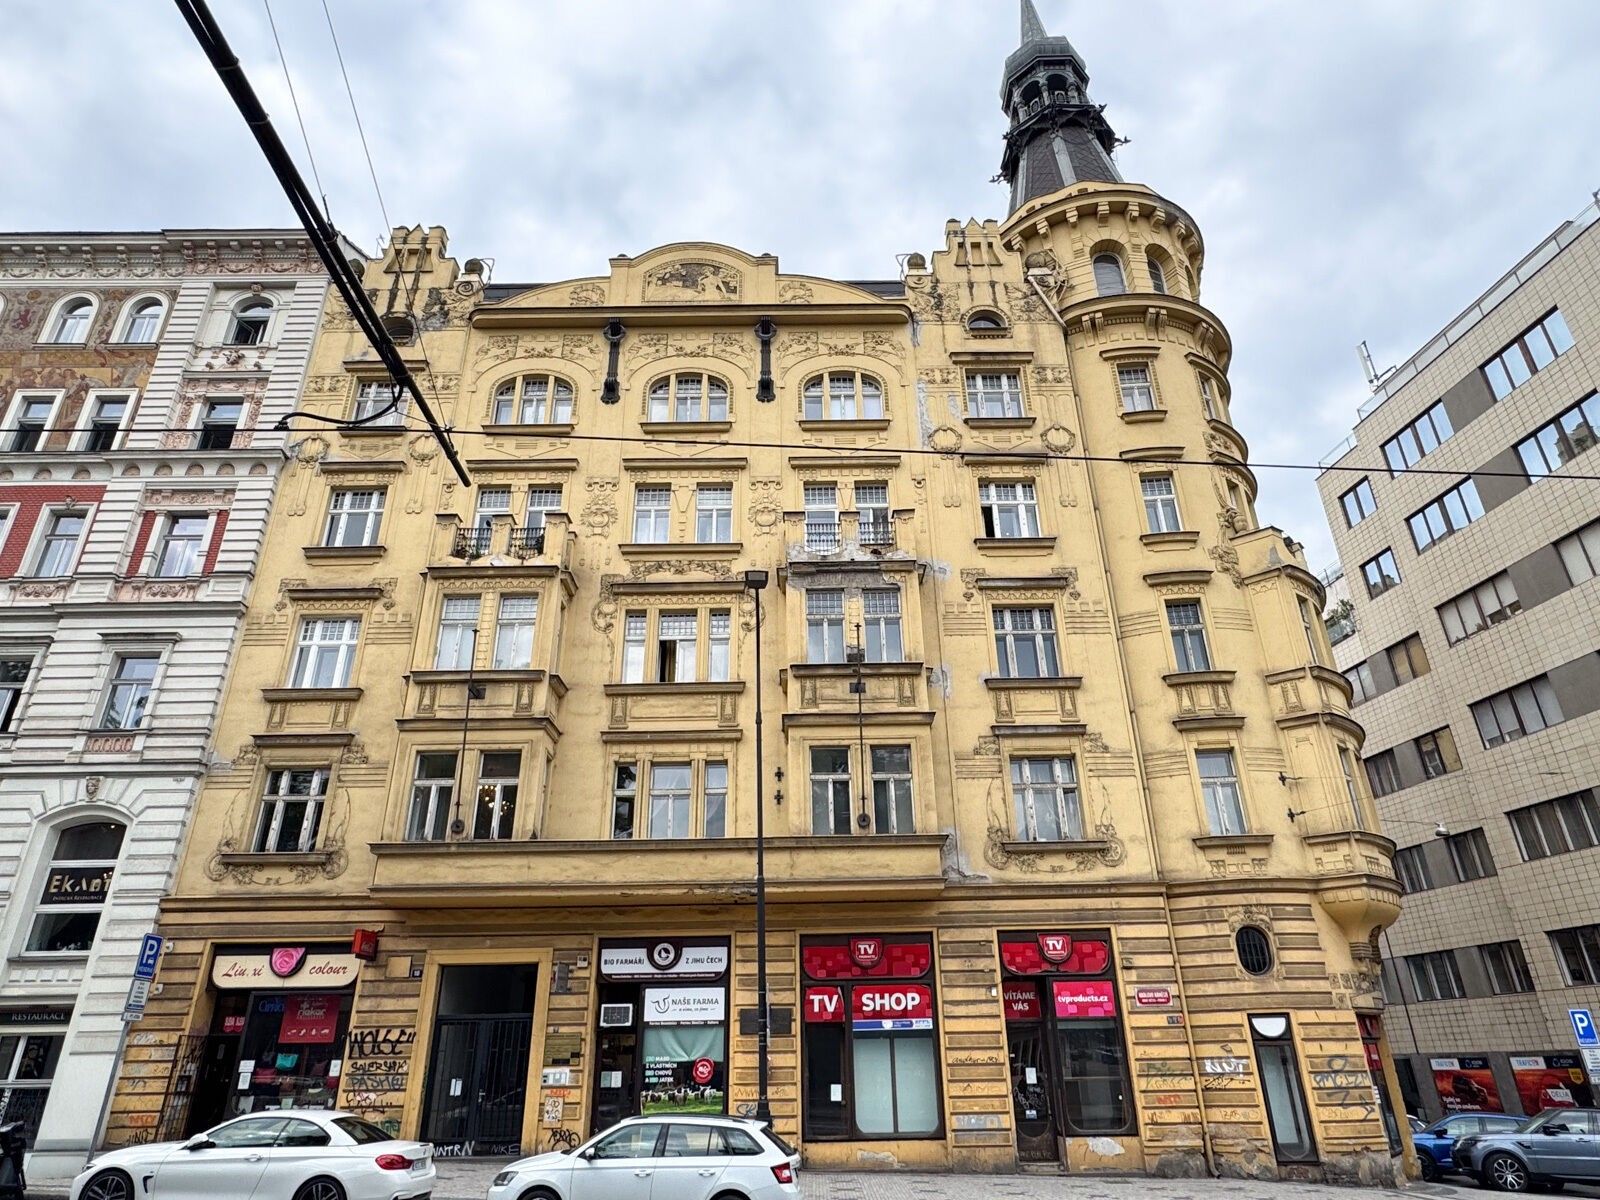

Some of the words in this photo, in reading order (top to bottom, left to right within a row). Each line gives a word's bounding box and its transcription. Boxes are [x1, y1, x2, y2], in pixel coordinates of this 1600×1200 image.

[858, 944, 875, 954] TV
[1046, 940, 1063, 951] TV
[143, 940, 158, 964] P
[706, 955, 723, 964] ČECH
[309, 961, 348, 975] colour
[1004, 990, 1036, 1000] VÍTÁME
[1058, 994, 1108, 1004] tvproducts.cz
[672, 997, 692, 1005] NAŠE
[810, 995, 838, 1013] TV
[861, 993, 920, 1012] SHOP
[1012, 1001, 1029, 1011] VÁS
[11, 1013, 65, 1021] RESTAURACE
[1574, 1013, 1588, 1035] P
